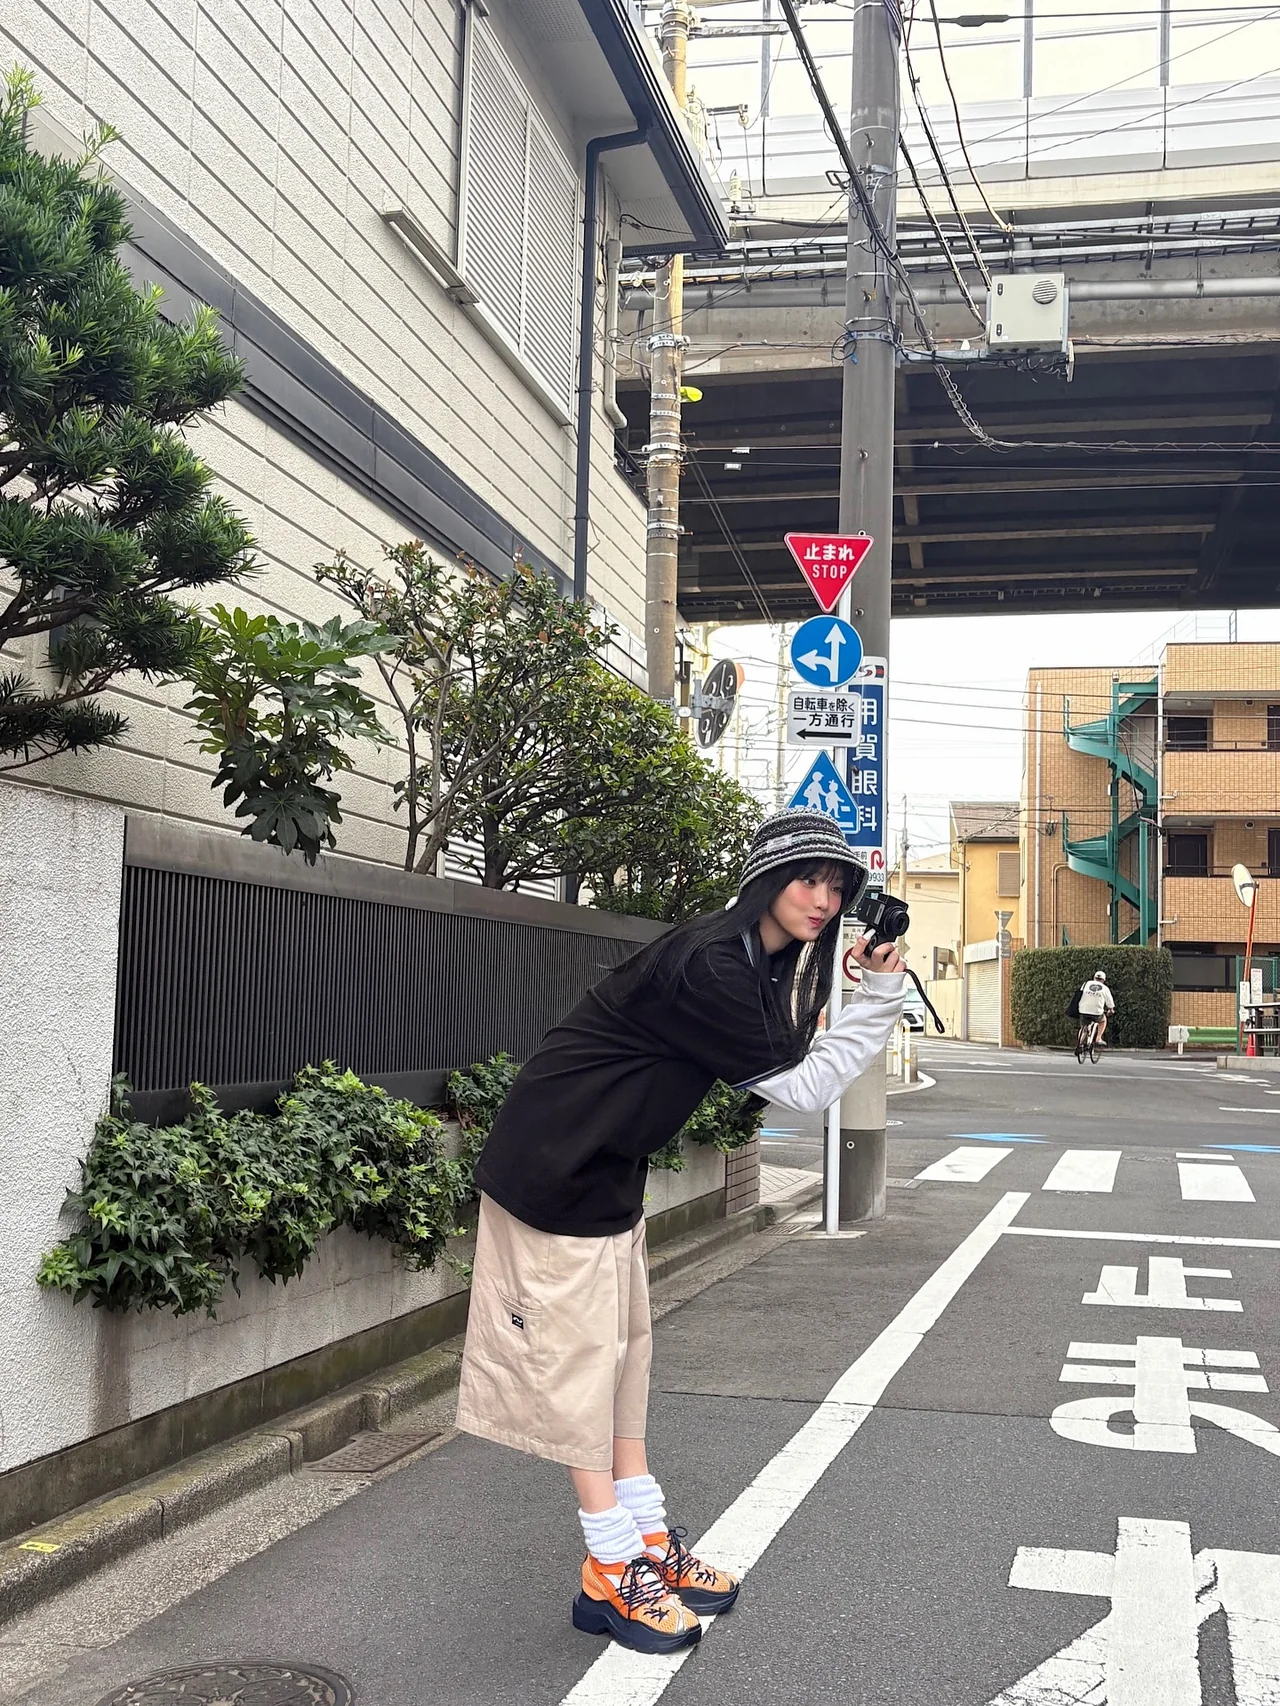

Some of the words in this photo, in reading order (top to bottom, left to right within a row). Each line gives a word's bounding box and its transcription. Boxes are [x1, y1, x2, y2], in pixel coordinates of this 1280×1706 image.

[803, 543, 855, 561] 止まれ
[812, 564, 847, 579] STOP
[793, 697, 855, 712] 自転車を除く
[793, 713, 855, 728] 一方通行
